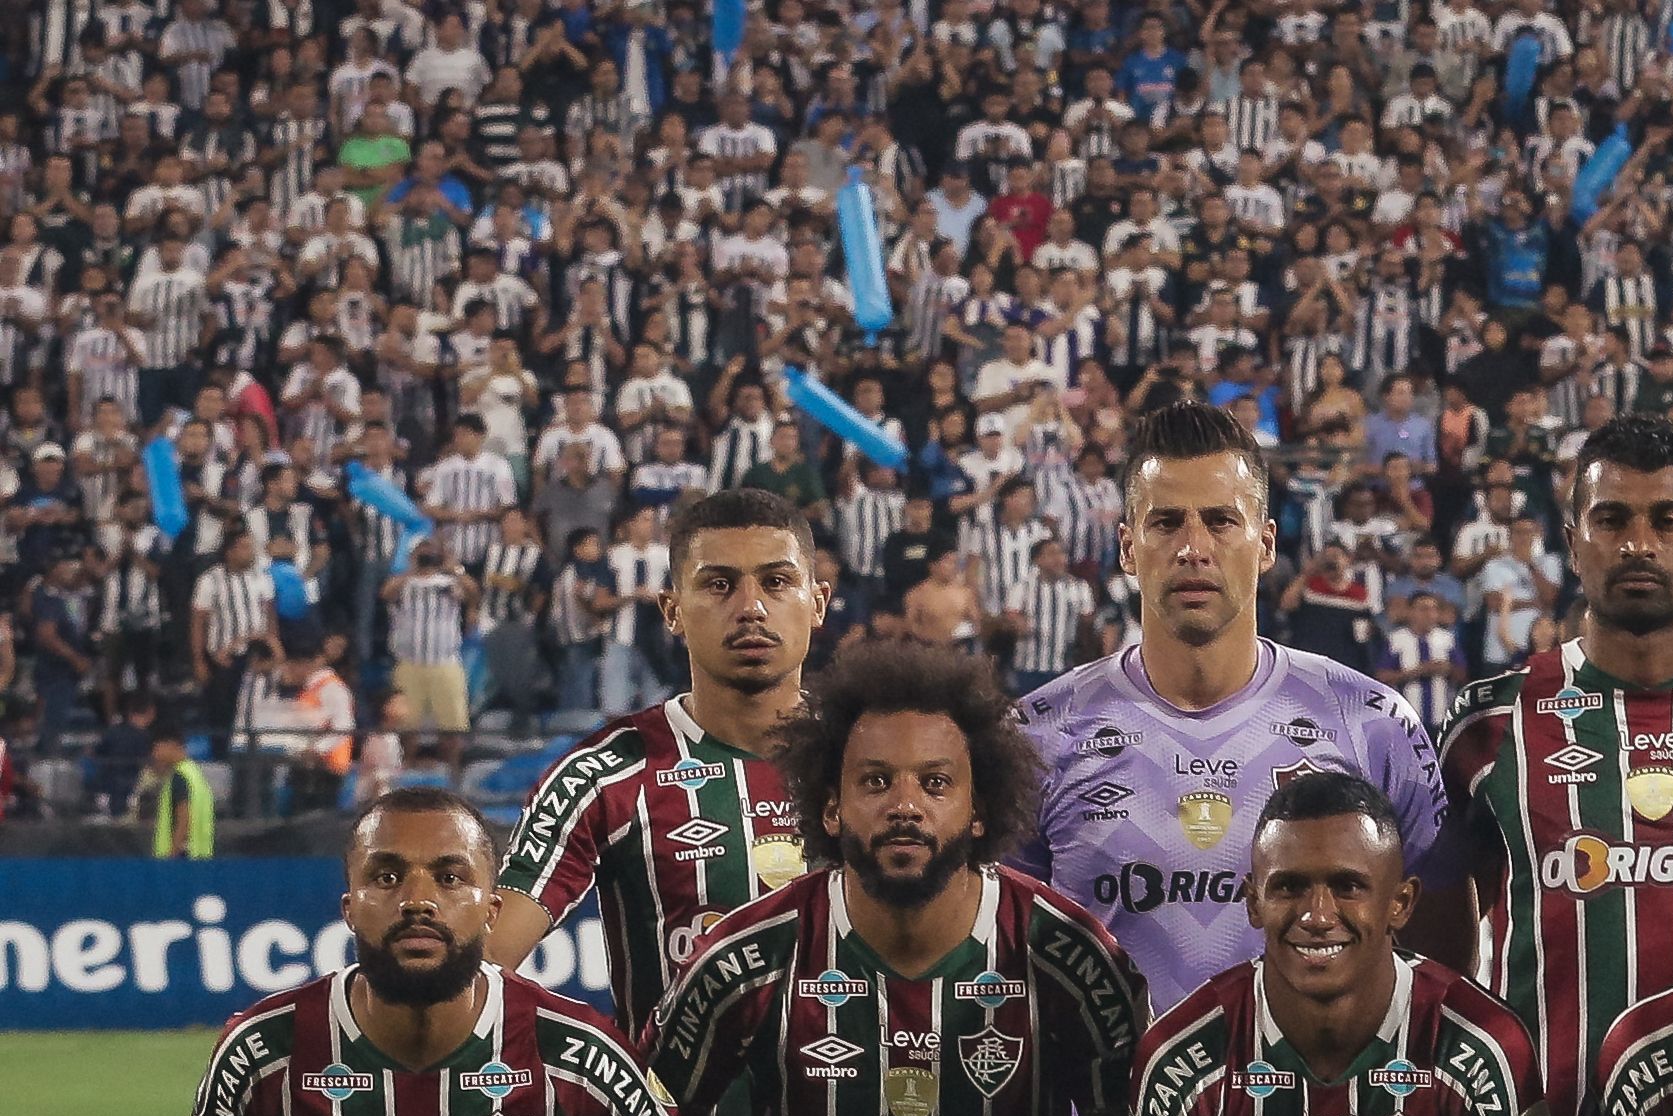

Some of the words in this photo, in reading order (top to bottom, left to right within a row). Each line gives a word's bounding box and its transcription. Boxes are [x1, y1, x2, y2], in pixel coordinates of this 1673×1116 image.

[1541, 697, 1600, 711] FRESCATTO
[1078, 732, 1141, 751] FRESCATTO
[1176, 753, 1238, 775] Leve
[660, 766, 722, 782] FRESCATTO
[1549, 770, 1597, 785] umbro
[521, 751, 623, 862] ZINZANE
[1083, 807, 1130, 822] umbro
[674, 845, 726, 862] umbro
[803, 983, 865, 994] FRESCATTO
[959, 984, 1022, 996] FRESCATTO
[1045, 930, 1133, 1056] ZINZAN
[668, 943, 766, 1060] ZINZANE
[880, 1025, 941, 1048] Leve
[805, 1065, 858, 1079] umbro
[306, 1076, 370, 1088] FRESCATTO
[465, 1073, 529, 1087] FRESCATTO
